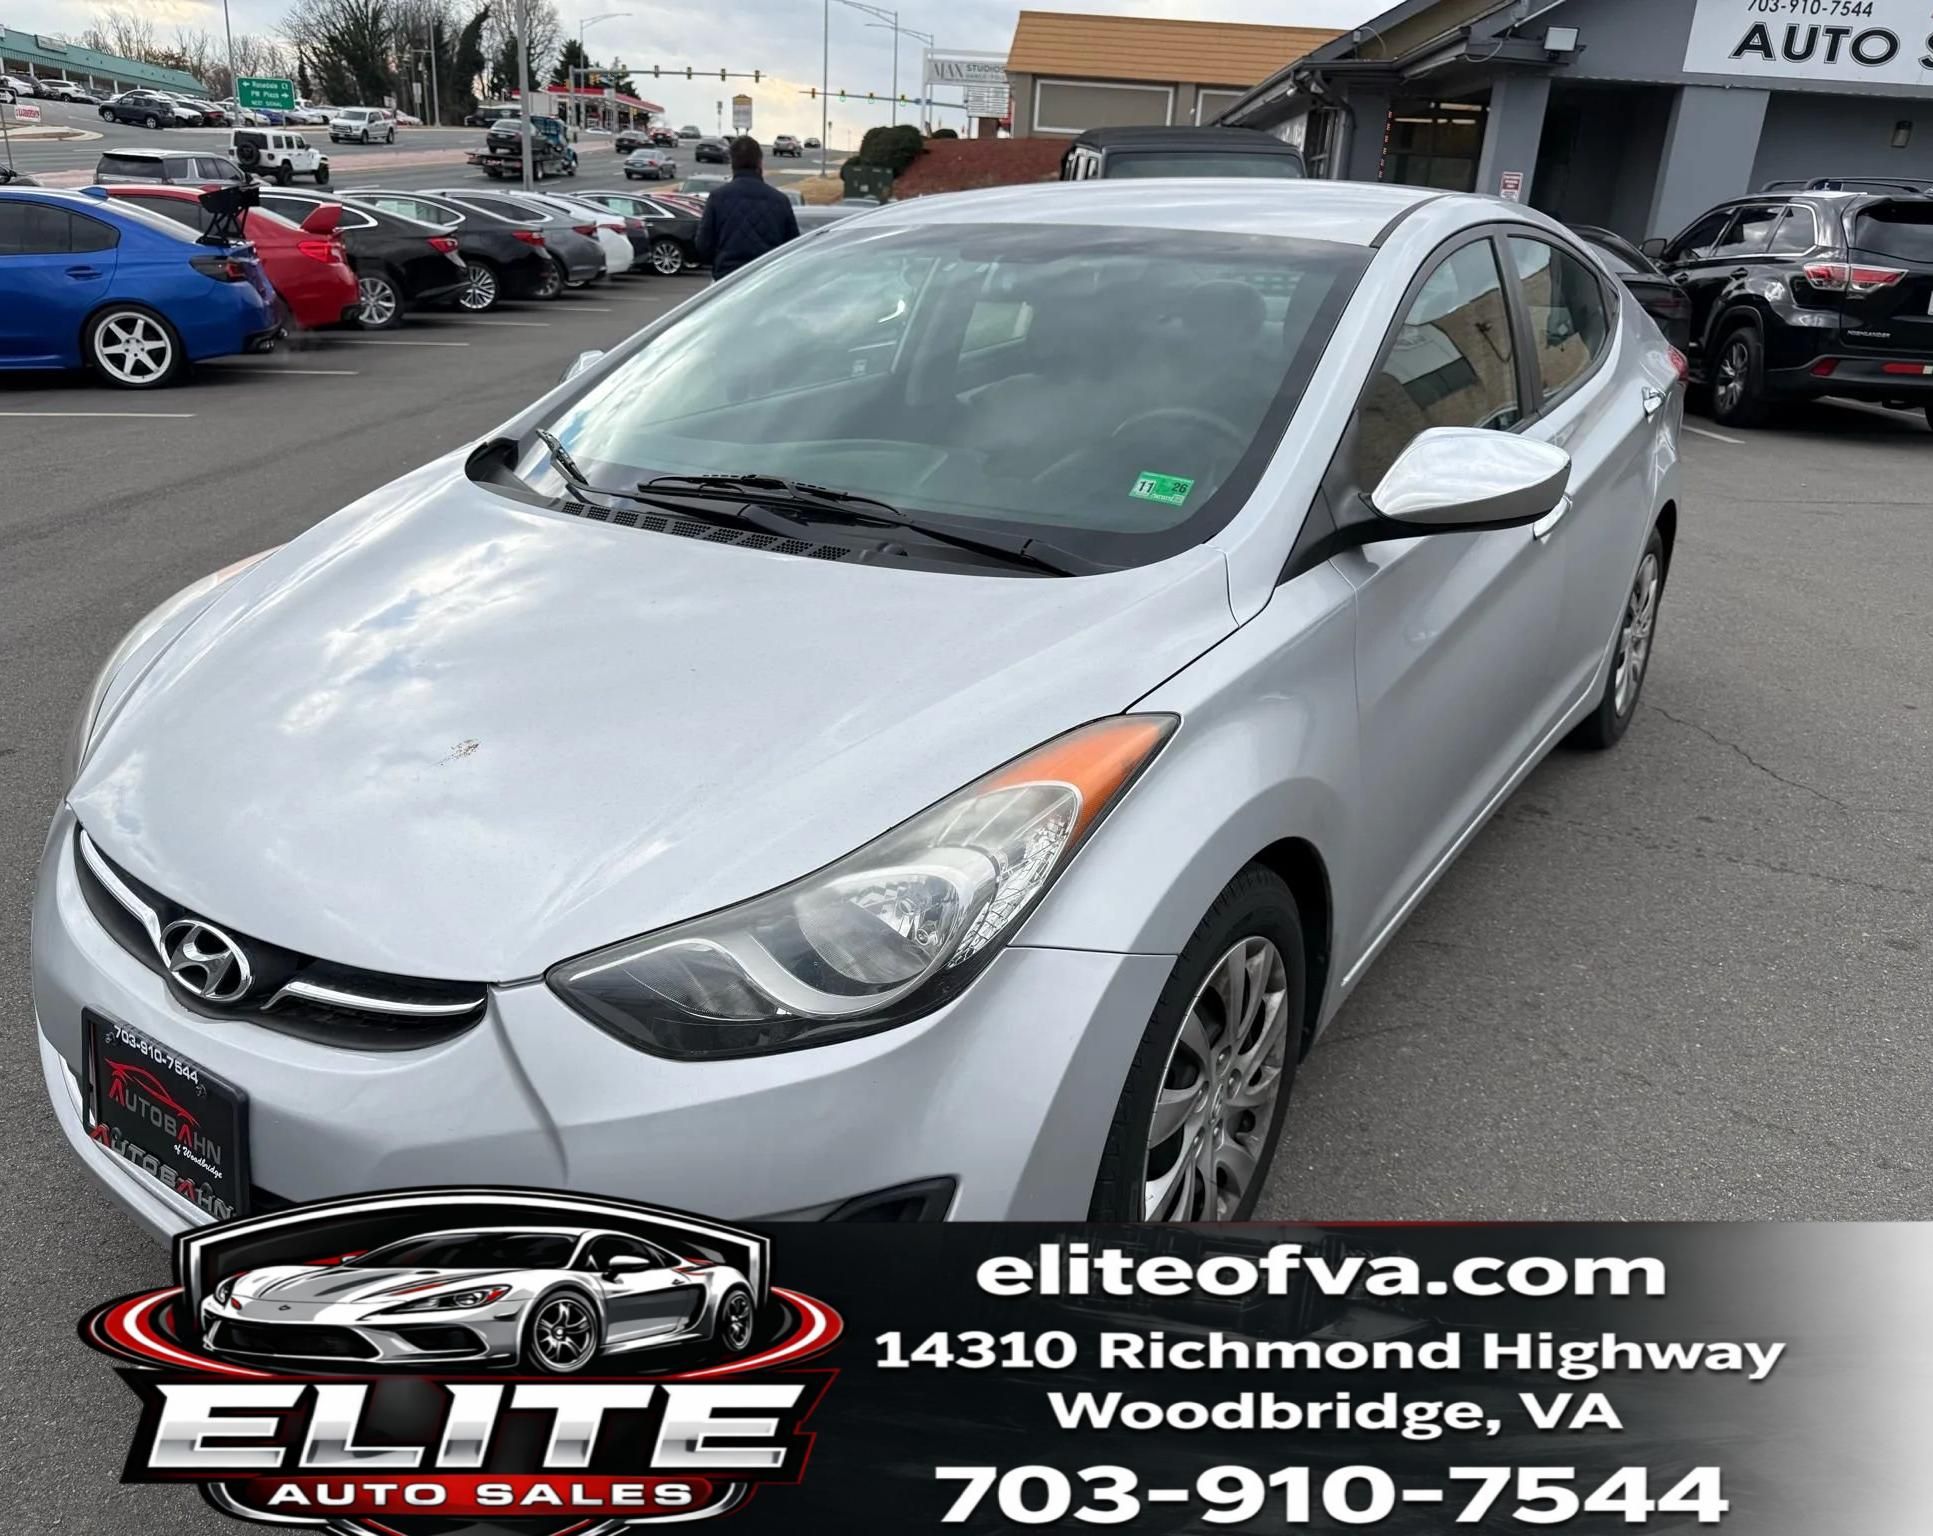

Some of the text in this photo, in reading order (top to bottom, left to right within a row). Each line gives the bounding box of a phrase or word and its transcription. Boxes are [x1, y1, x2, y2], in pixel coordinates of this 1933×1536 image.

[1747, 0, 1874, 18] 703-910-7544
[1728, 21, 1901, 68] AUTO
[931, 63, 963, 79] MAX
[1138, 480, 1189, 494] 11 26
[113, 1024, 199, 1085] 703-910-7544
[108, 1077, 222, 1165] AUTOBAHN
[89, 1122, 235, 1220] AUTOBAHN
[173, 1144, 223, 1179] of Woodbridge
